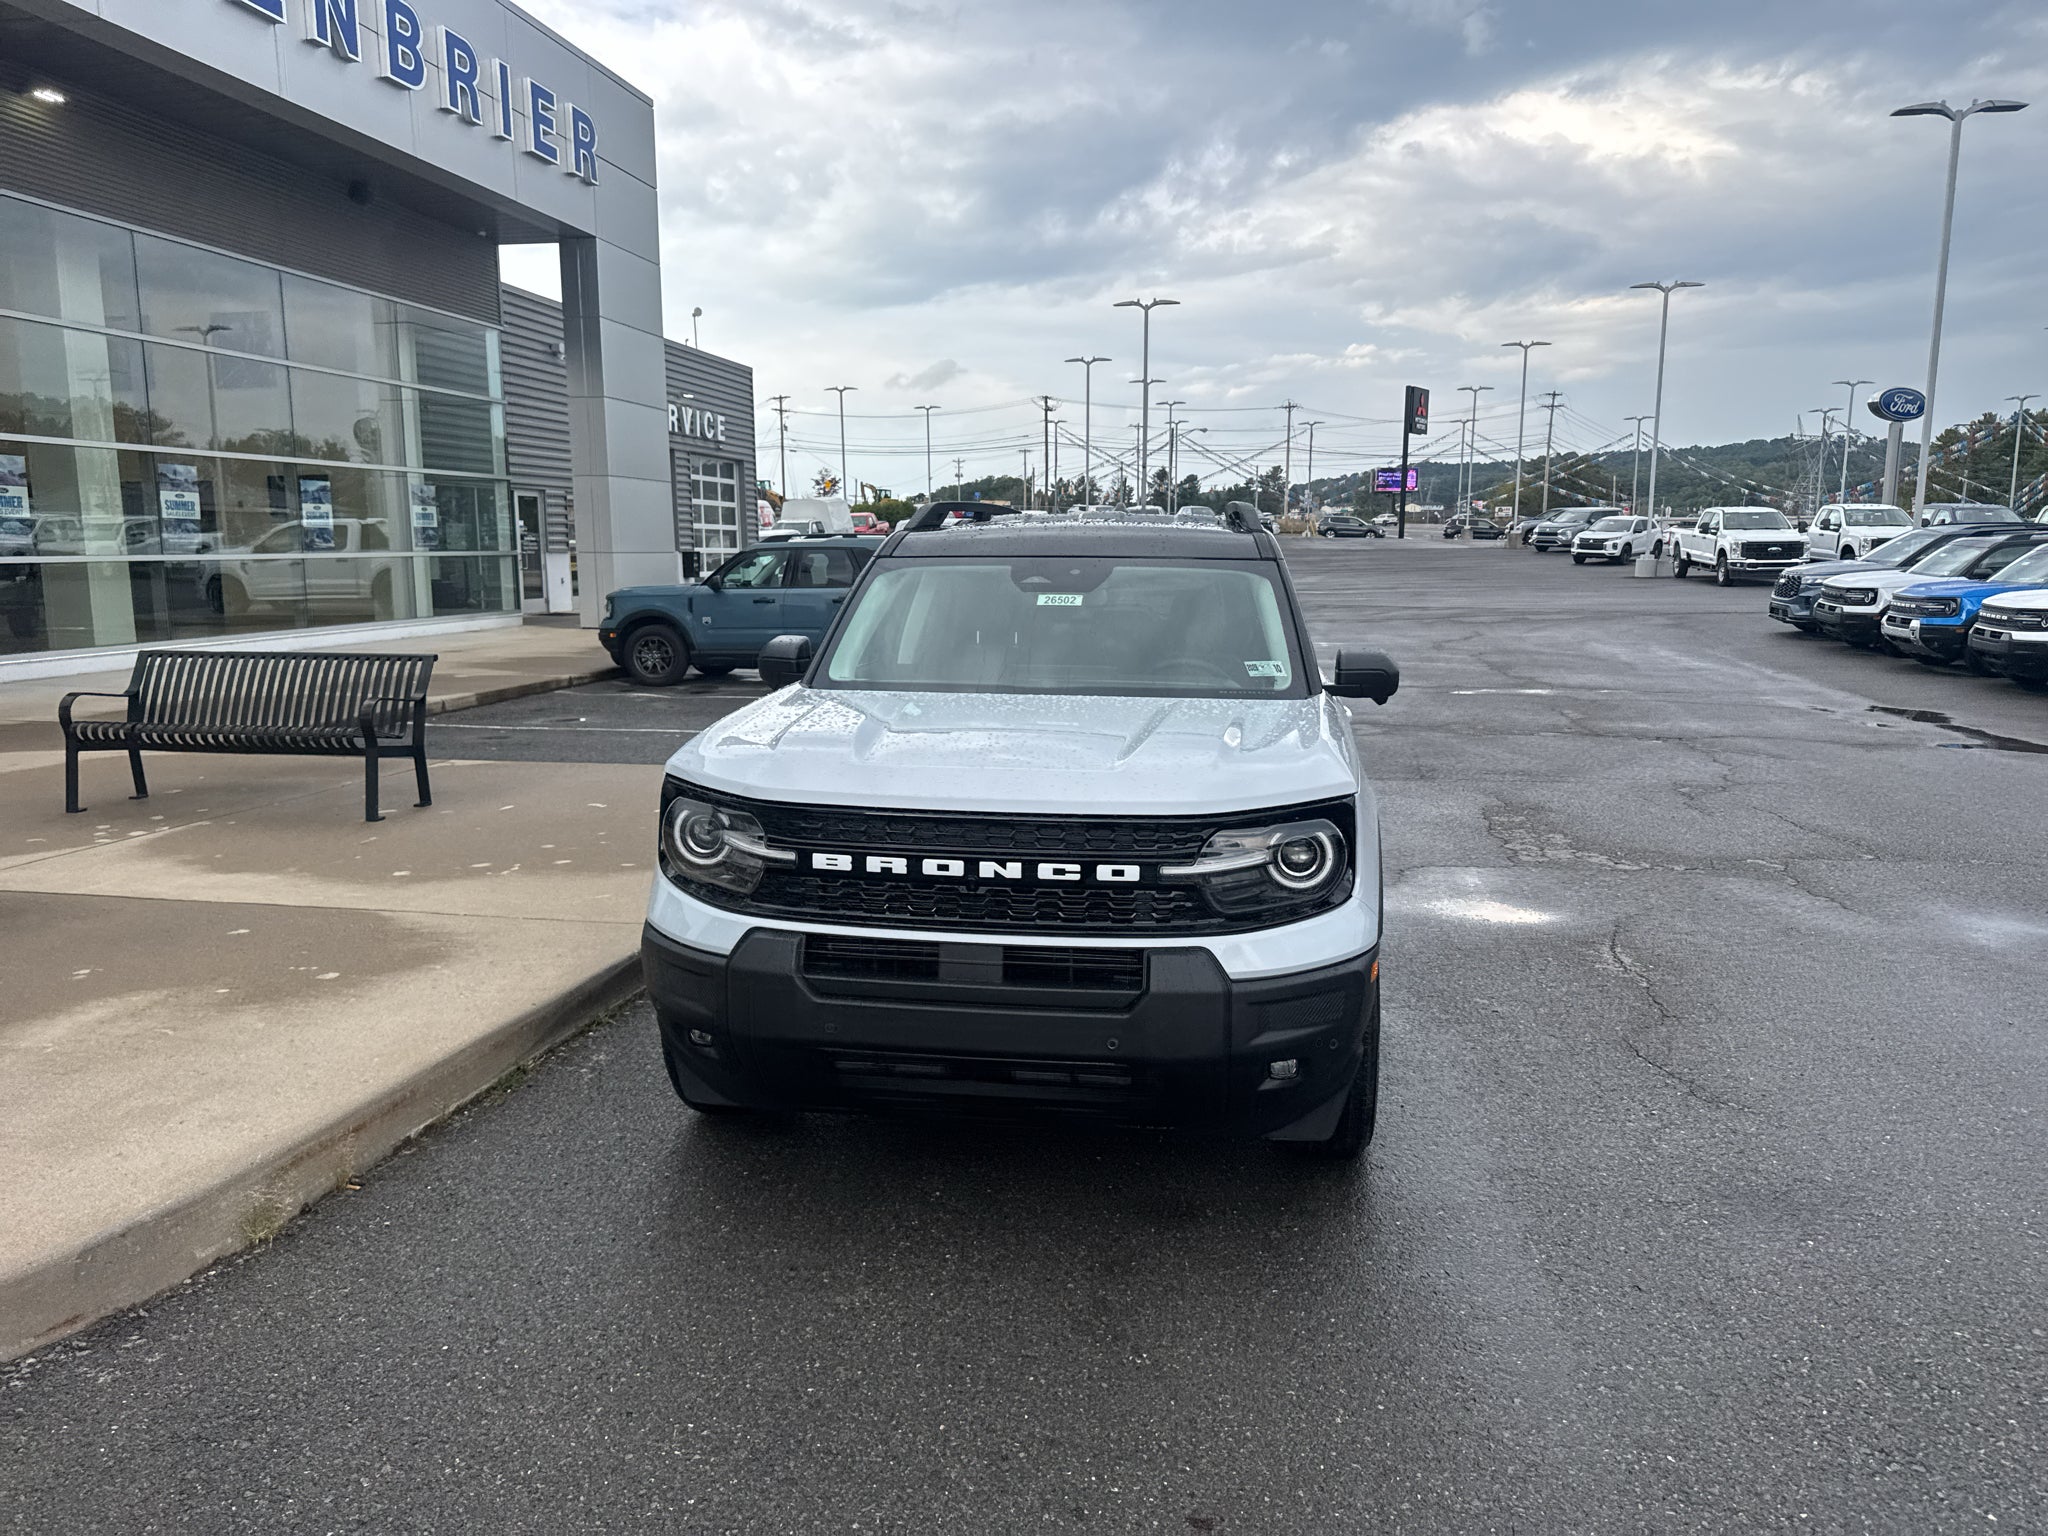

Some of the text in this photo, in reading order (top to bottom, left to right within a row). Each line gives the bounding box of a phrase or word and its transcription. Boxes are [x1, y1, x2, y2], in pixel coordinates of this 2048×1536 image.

[233, 0, 600, 187] NBRIER
[164, 499, 196, 511] SUMMER
[1043, 595, 1077, 604] 26502
[812, 852, 1141, 882] BRONCO
